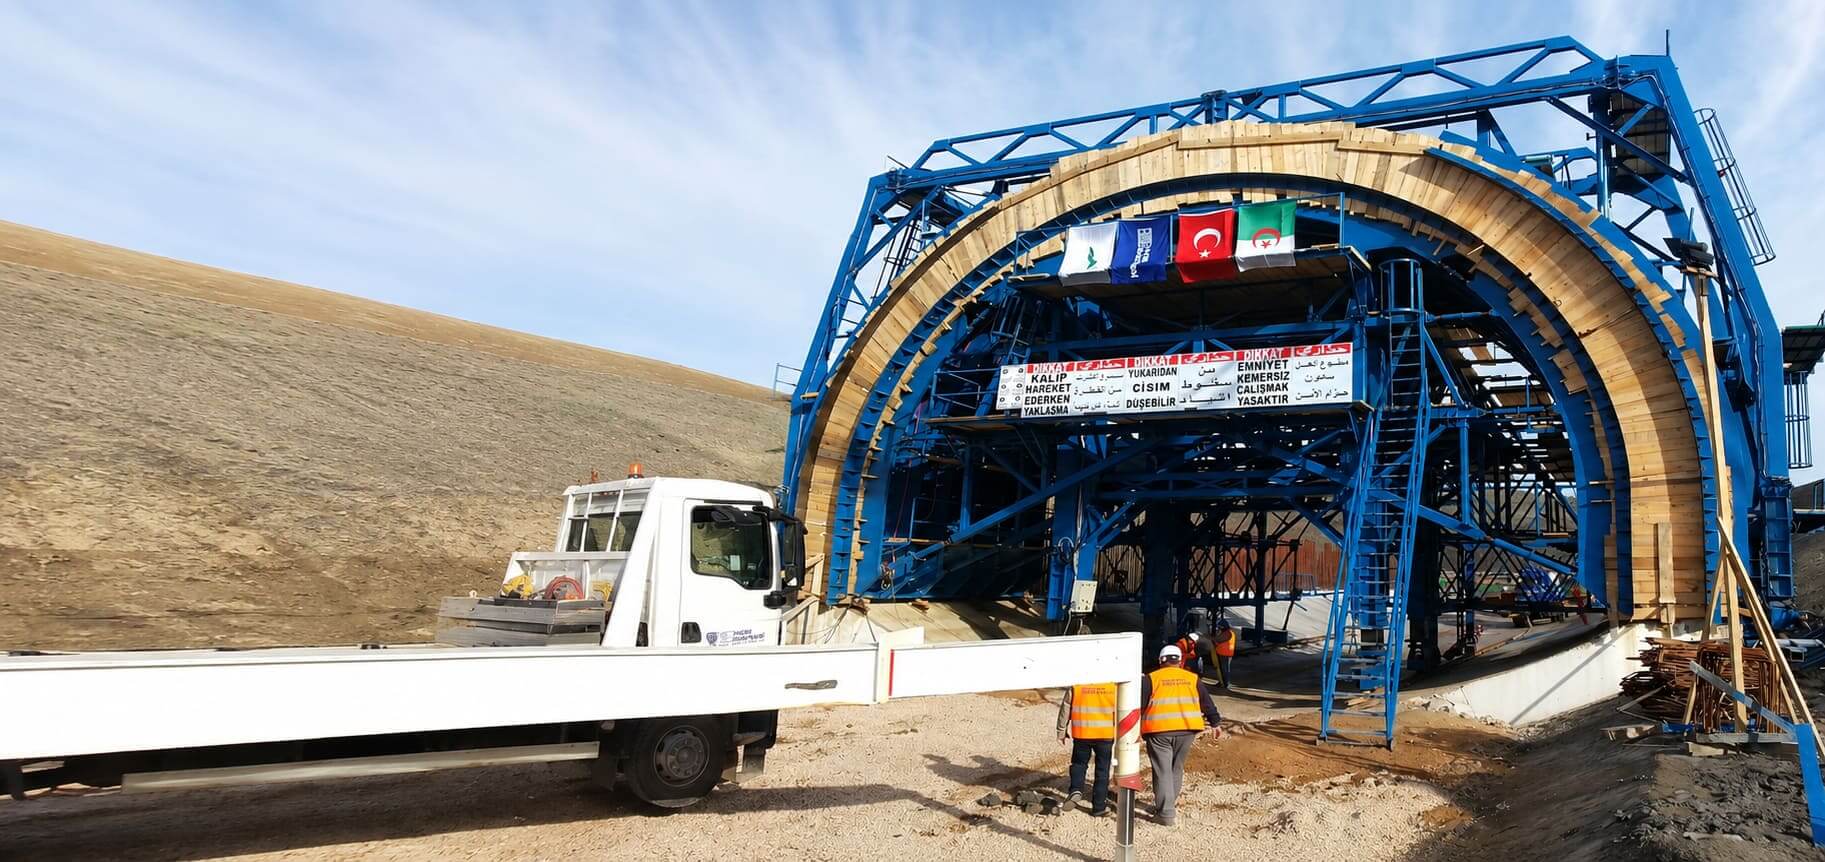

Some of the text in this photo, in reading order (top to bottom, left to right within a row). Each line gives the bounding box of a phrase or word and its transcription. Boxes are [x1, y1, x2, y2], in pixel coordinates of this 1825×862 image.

[1031, 373, 1067, 383] KALIP
[1128, 367, 1178, 378] YUKARIDAN
[1025, 384, 1071, 394] HAREKET
[1024, 394, 1070, 405] EDERKEN
[1237, 394, 1289, 406] YASAKTIR
